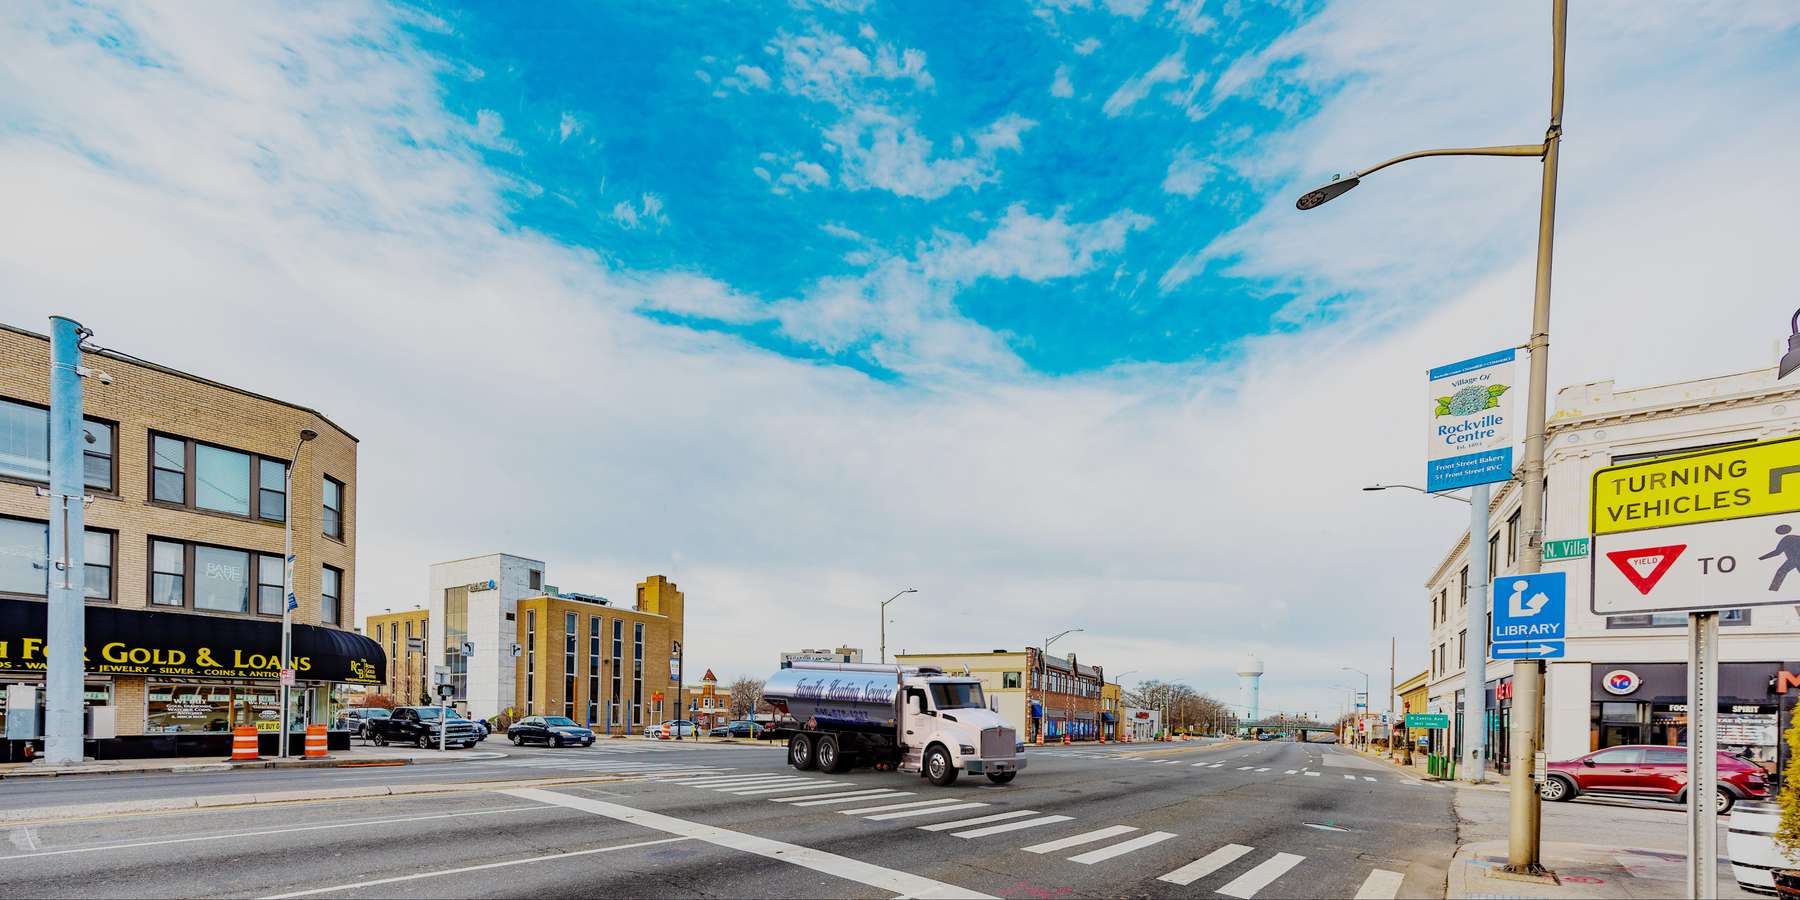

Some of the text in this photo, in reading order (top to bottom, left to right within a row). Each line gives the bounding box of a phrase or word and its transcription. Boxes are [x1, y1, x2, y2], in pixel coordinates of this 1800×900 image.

[1451, 373, 1491, 387] Village Of
[1438, 414, 1504, 436] Rockville
[1445, 428, 1495, 445] Centre
[1455, 458, 1478, 468] Street
[1479, 455, 1504, 464] Bakery
[1464, 466, 1485, 475] Street
[1611, 459, 1748, 496] TURNING
[1607, 488, 1752, 523] VEHICLES
[1546, 543, 1557, 558] N.
[1633, 557, 1658, 566] YIELD
[1697, 555, 1736, 575] TO
[1496, 622, 1560, 637] LIBRARY
[102, 642, 186, 665] GOLD
[195, 647, 223, 668] &
[233, 649, 312, 671] LOANS
[99, 664, 149, 673] JEWELRY
[159, 667, 194, 675] SILVER
[793, 677, 892, 707] Family Heating Service
[1732, 705, 1760, 713] SPIRIT
